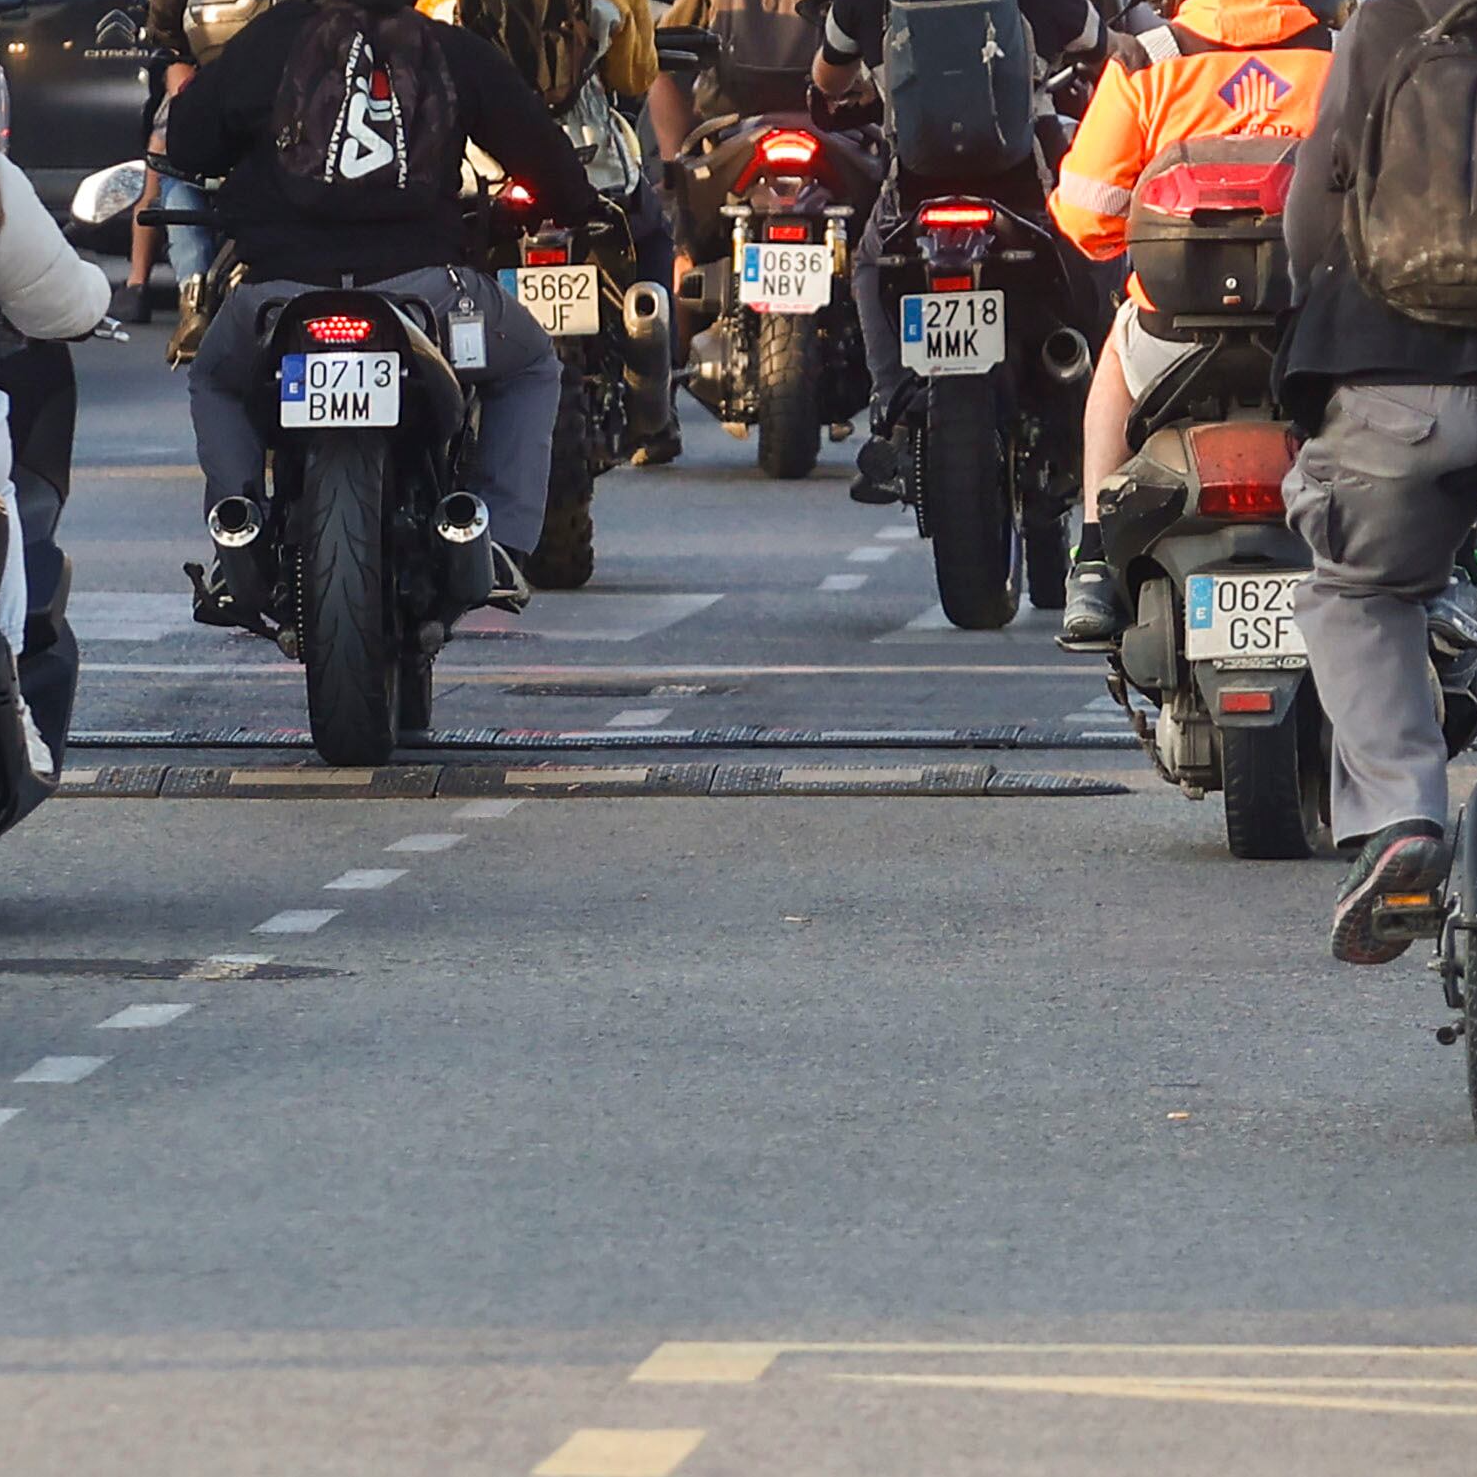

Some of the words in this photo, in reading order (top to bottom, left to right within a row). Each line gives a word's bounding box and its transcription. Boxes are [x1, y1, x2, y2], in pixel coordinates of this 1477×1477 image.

[764, 251, 822, 273] 0636
[523, 273, 591, 301] 5662
[763, 275, 806, 296] NBV
[927, 298, 997, 328] 2718
[927, 329, 979, 359] MMK
[289, 382, 299, 394] E
[310, 360, 391, 389] 0713
[309, 392, 370, 421] BMM
[1195, 607, 1207, 620] E
[1230, 616, 1293, 650] GSF
